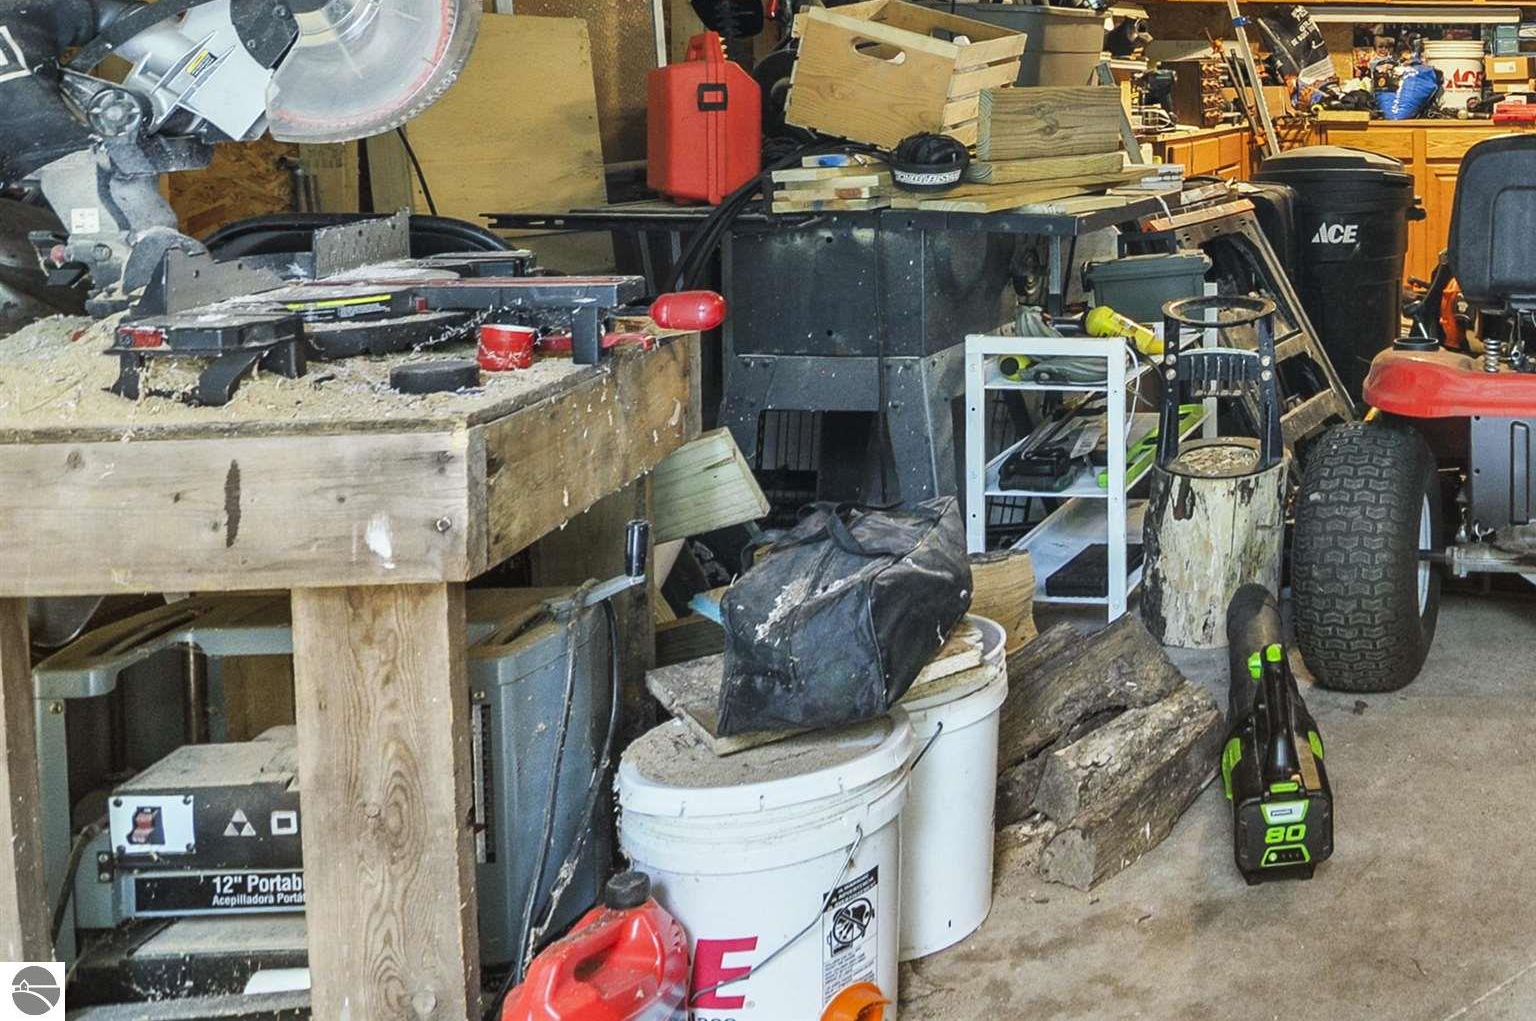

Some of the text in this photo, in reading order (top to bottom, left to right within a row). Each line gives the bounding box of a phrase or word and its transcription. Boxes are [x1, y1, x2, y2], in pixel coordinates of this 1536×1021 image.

[1311, 222, 1359, 244] ACE
[1264, 823, 1307, 844] 80
[212, 872, 304, 894] 12" Portab
[277, 891, 304, 904] Portá
